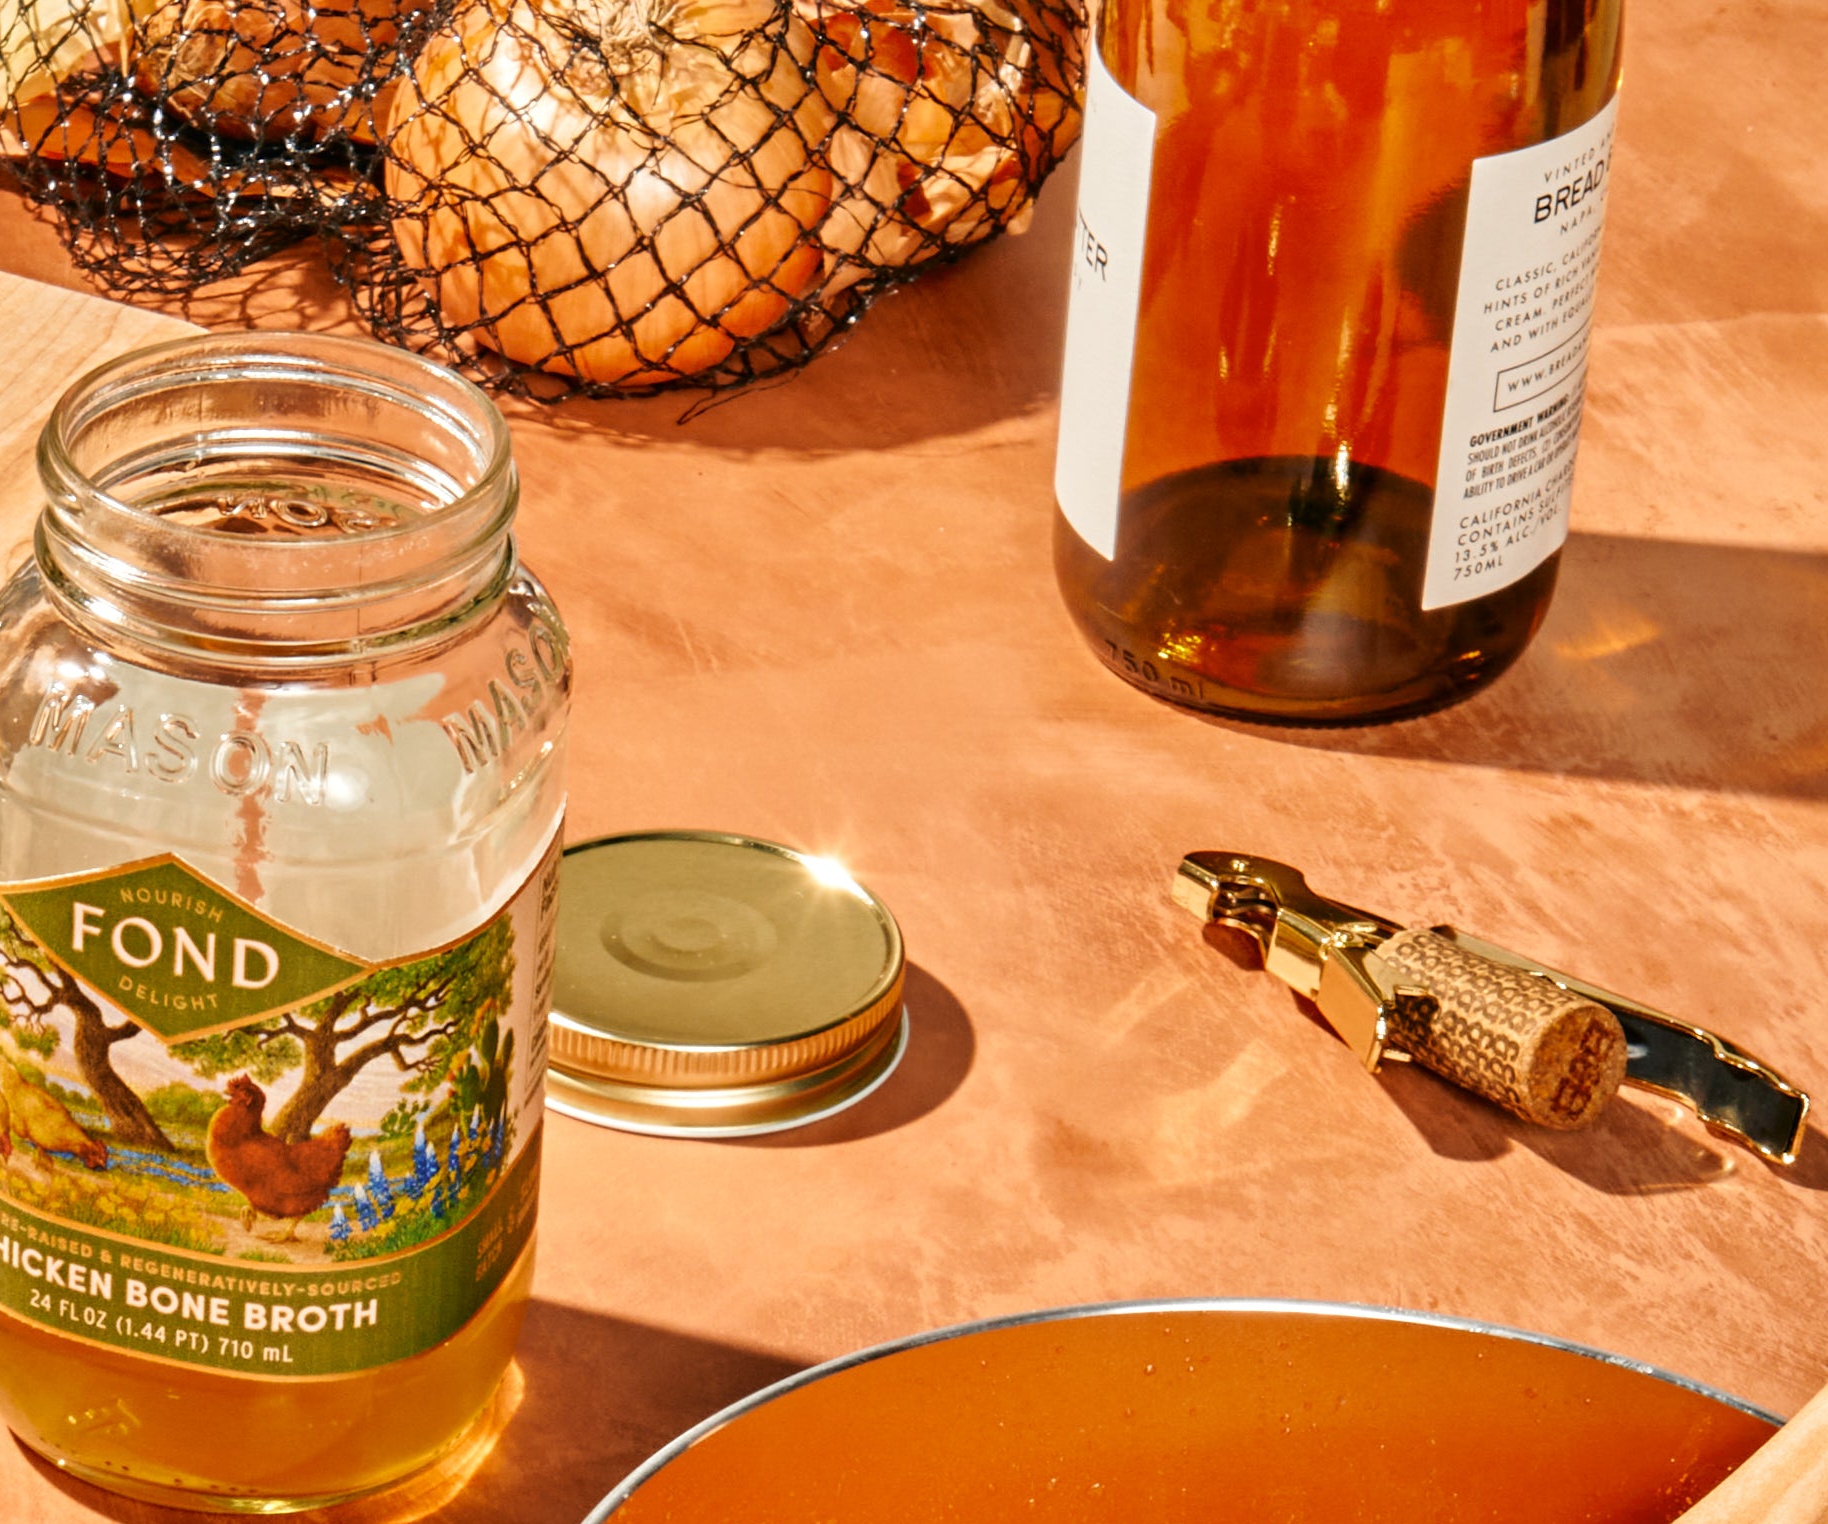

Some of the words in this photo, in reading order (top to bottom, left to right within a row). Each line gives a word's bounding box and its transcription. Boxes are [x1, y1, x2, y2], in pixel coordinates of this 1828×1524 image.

[1544, 147, 1595, 183] VINTED
[1534, 159, 1604, 224] BREAD
[1483, 291, 1528, 315] HINTS
[1533, 282, 1550, 299] OF
[1554, 268, 1578, 290] RICH
[1495, 261, 1557, 292] CLASSIC,
[1551, 273, 1590, 310] PERFECT
[1490, 334, 1523, 353] AND
[1528, 317, 1559, 340] WITH
[1467, 445, 1500, 466] SHOULD
[1501, 438, 1517, 455] NOT
[1517, 429, 1539, 450] DRINK
[1469, 416, 1534, 448] GOVERNMENT
[1463, 480, 1494, 499] ABILITY
[1495, 475, 1506, 490] TO
[1506, 465, 1528, 487] DRIVE
[1465, 467, 1477, 483] OF
[1481, 460, 1504, 478] BIRTH
[1457, 507, 1534, 547] CONTAINS
[1459, 487, 1542, 530] CALIFORNIA
[1453, 555, 1503, 581] 750ML
[1455, 540, 1499, 563] 13.5%
[1104, 637, 1160, 683] 750
[441, 621, 570, 775] MASO
[28, 681, 330, 805] MASON
[120, 887, 225, 924] NOURISH
[72, 901, 280, 990] FOND
[118, 975, 219, 1012] DELIGHT
[100, 1249, 113, 1264] &
[120, 1253, 403, 1298] REGENERATIVELY-SOURCED
[125, 1278, 230, 1327] BONE
[244, 1298, 379, 1334] BROTH
[29, 1288, 52, 1314] 24
[115, 1316, 167, 1343] (1.44
[174, 1330, 210, 1355] PT)
[218, 1336, 254, 1361] 710
[262, 1344, 294, 1364] mL
